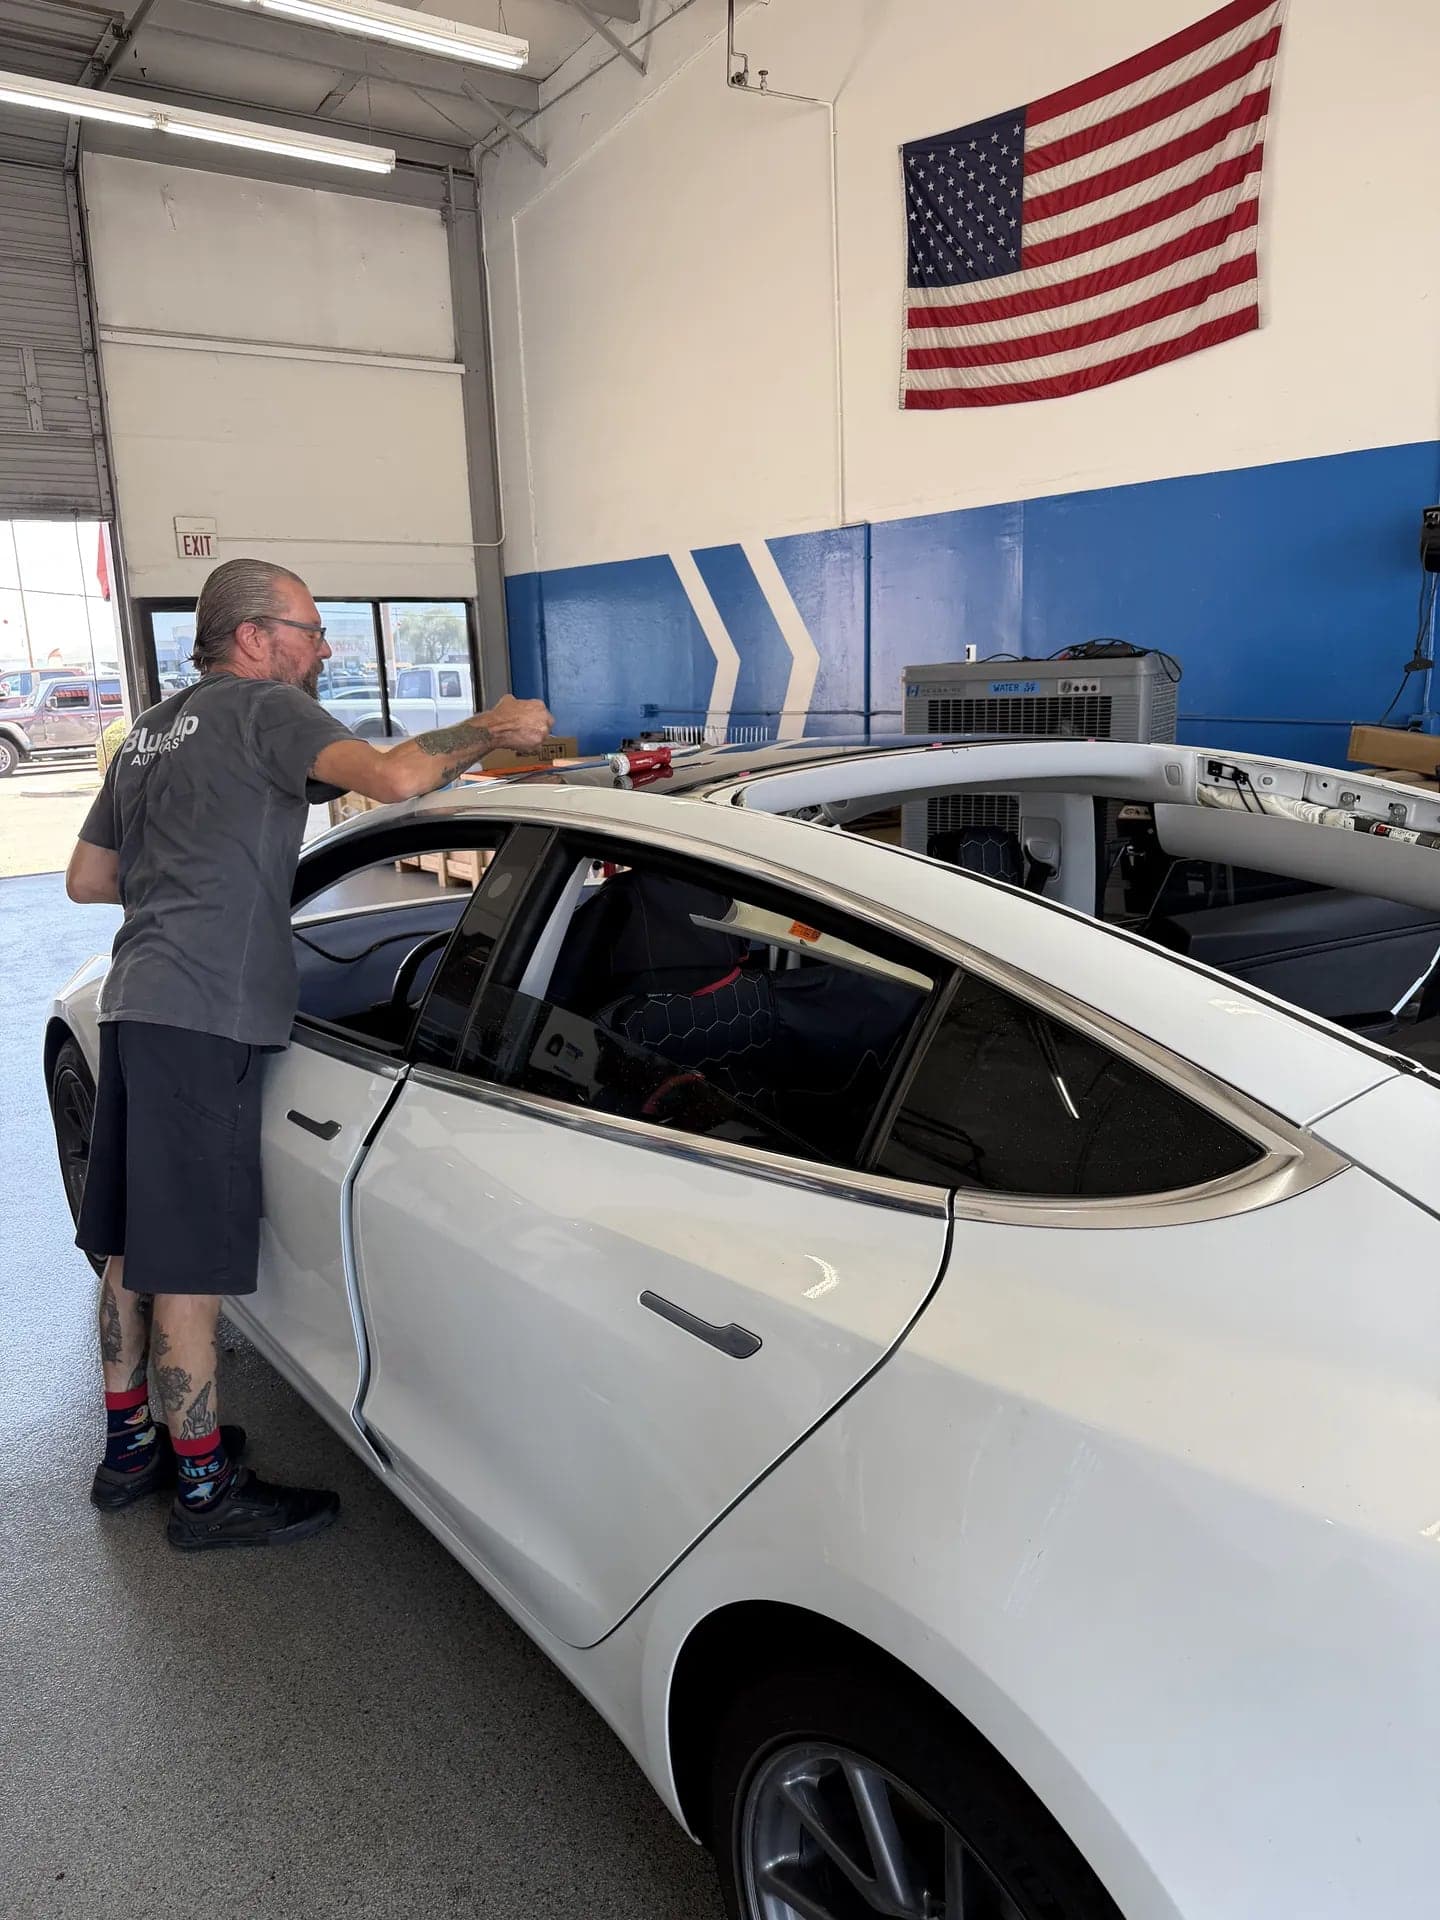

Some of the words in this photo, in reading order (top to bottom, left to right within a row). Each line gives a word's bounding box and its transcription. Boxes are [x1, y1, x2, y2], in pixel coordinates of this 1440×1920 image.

[183, 535, 212, 556] EXIT
[992, 683, 1020, 692] WATER
[181, 1461, 220, 1477] TITS
